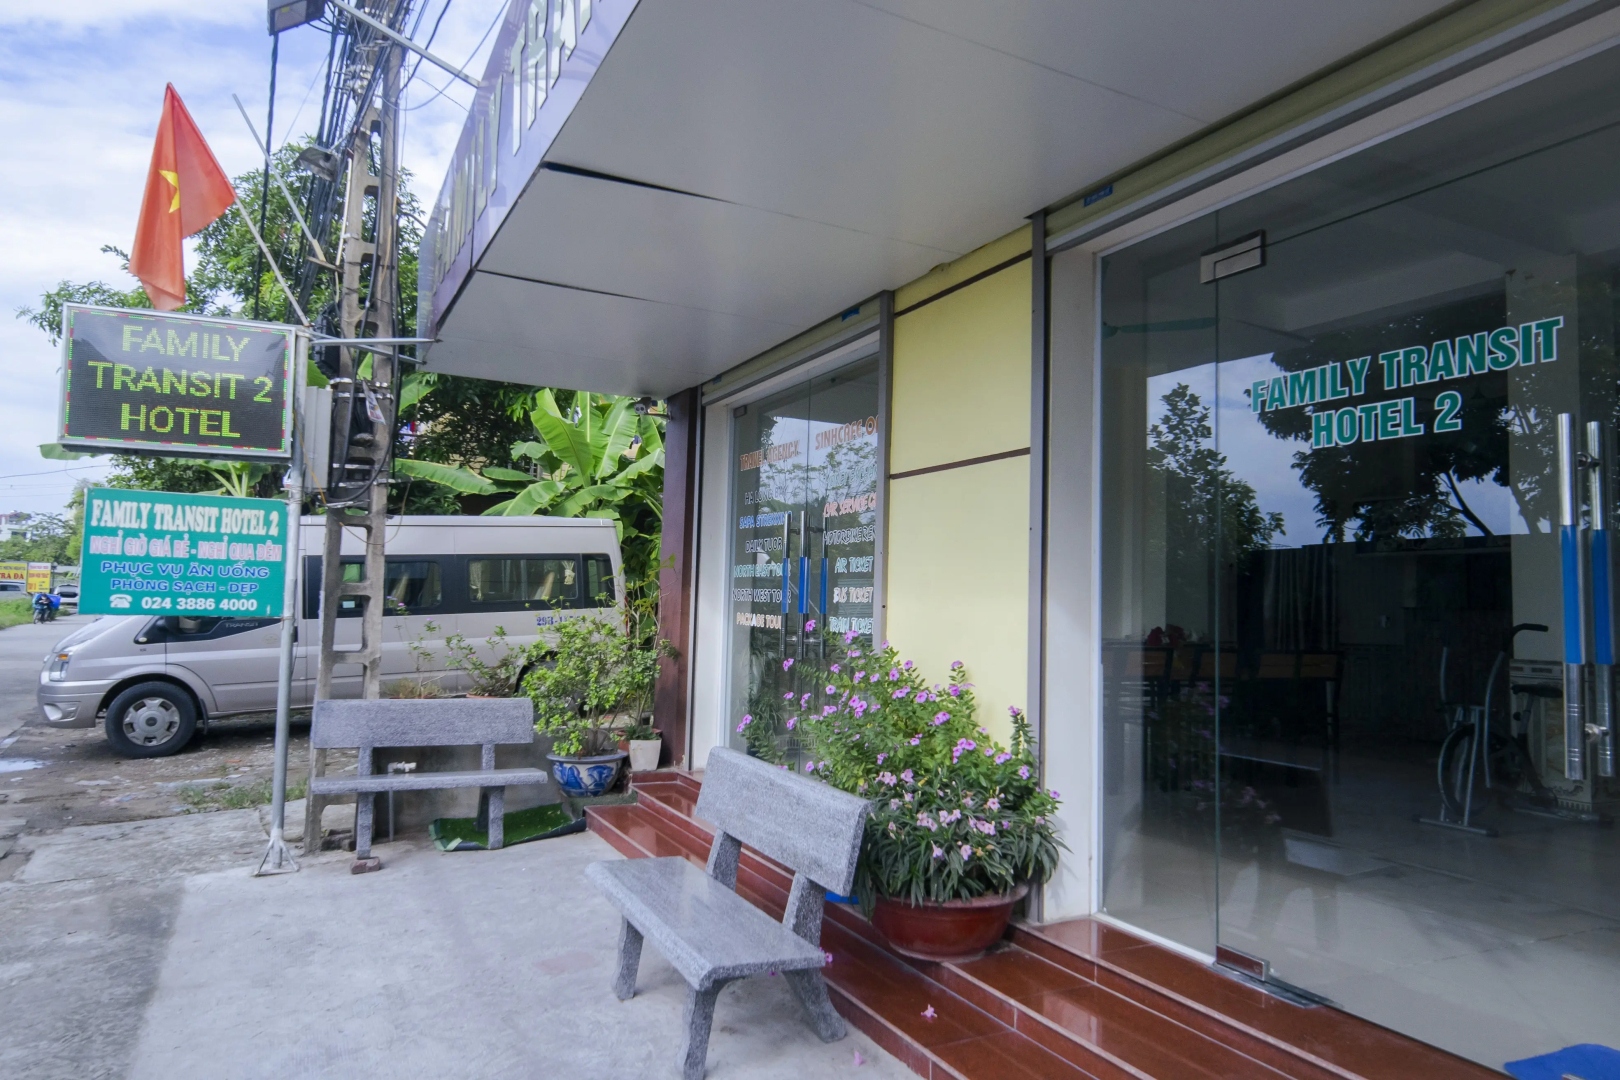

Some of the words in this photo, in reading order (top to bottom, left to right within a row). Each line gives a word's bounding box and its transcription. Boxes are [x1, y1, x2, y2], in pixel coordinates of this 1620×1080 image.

[122, 324, 251, 362] FAMILY
[1251, 355, 1371, 414] FAMILY
[1379, 316, 1564, 390] TRANSIT
[88, 360, 245, 400] TRANSIT
[253, 376, 273, 403] 2
[120, 403, 241, 438] HOTEL
[1311, 397, 1424, 449] HOTEL
[1433, 390, 1462, 433] 2
[766, 440, 799, 464] AGENCY
[90, 499, 152, 530] FAMILY
[153, 503, 219, 533] TRANSIT
[220, 507, 267, 536] HOTEL
[268, 510, 279, 537] 2
[739, 514, 755, 529] SAPA
[89, 529, 123, 555] NGHỈ
[148, 534, 172, 558] GIÁ
[173, 533, 190, 558] RẺ
[197, 535, 228, 560] NGHỈ
[229, 542, 255, 561] QUA
[256, 540, 283, 562] ĐÊM
[101, 561, 153, 578] PHỤC
[158, 563, 184, 578] VỤ
[187, 561, 213, 577] ĂN
[218, 560, 270, 579] UỐNG
[734, 563, 755, 578] NORTH
[834, 557, 847, 573] AIR
[849, 556, 874, 573] TICKET
[110, 578, 169, 592] PHÒNG
[173, 580, 216, 595] SẠCH
[732, 588, 753, 602] NORTH
[753, 588, 771, 603] WEST
[849, 586, 874, 604] TICKET
[141, 596, 172, 610] 024
[176, 596, 216, 610] 3886
[219, 598, 258, 611] 4000
[736, 612, 765, 628] PACKAGE
[829, 616, 850, 633] TRAIN
